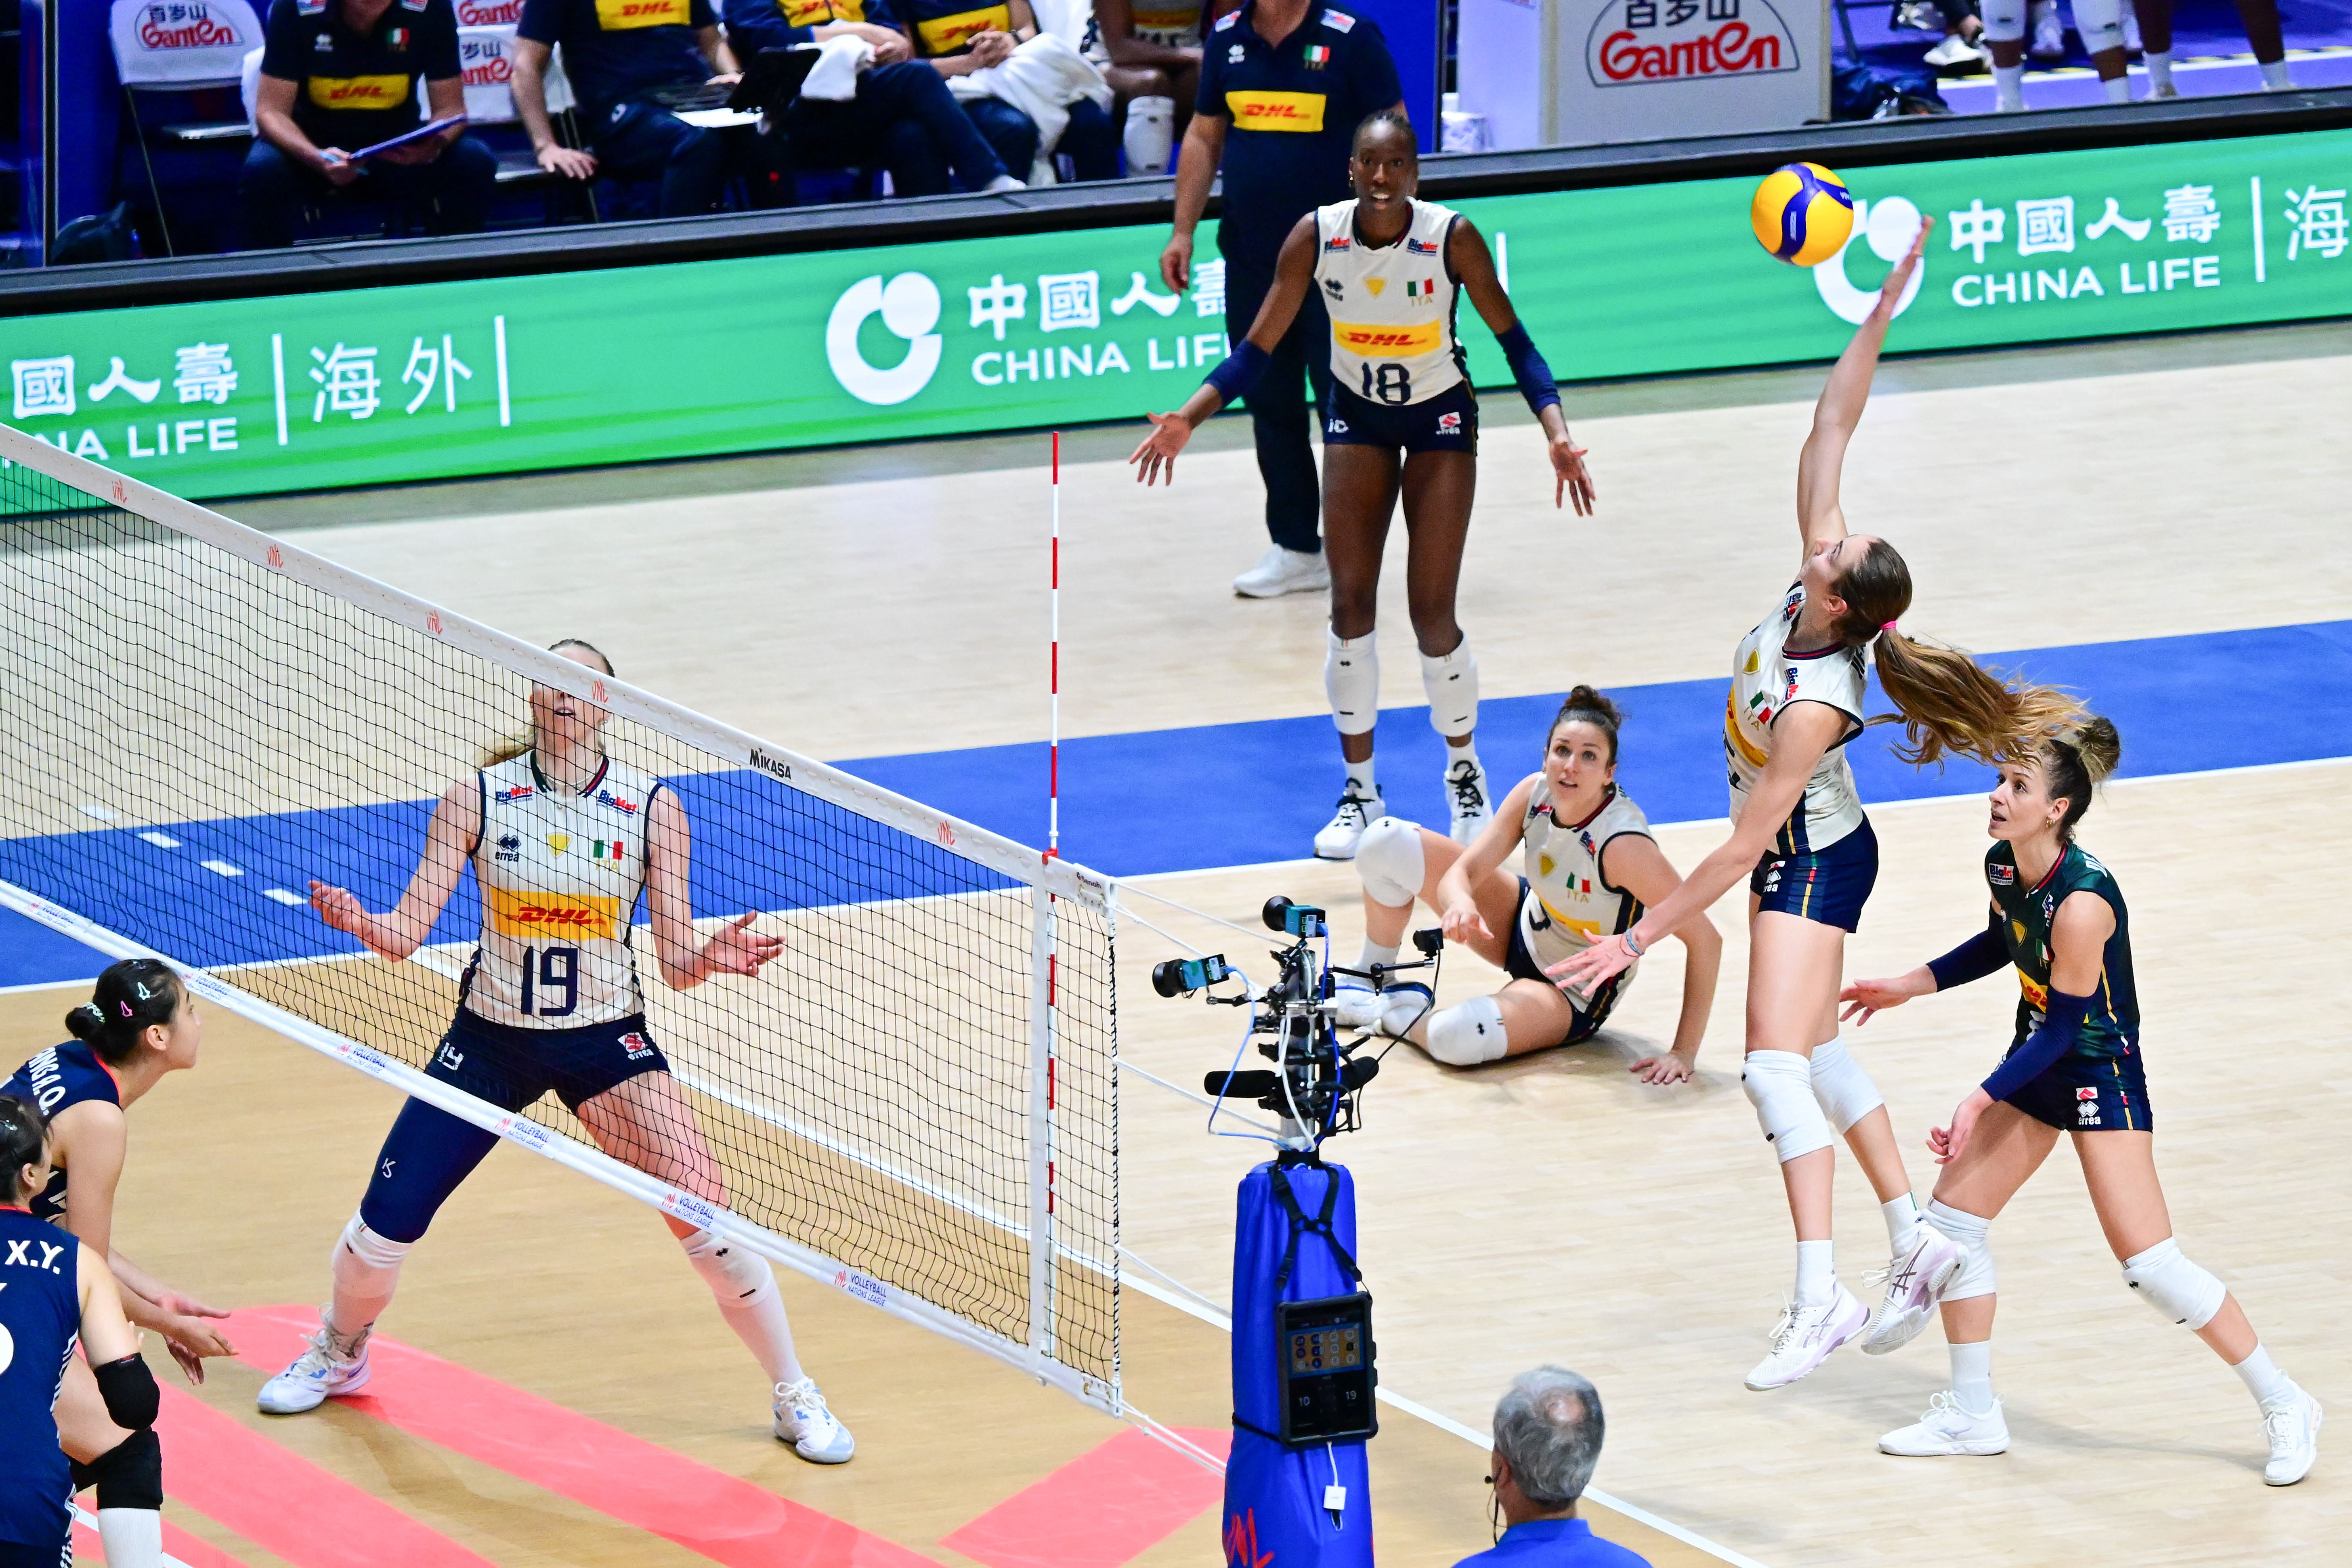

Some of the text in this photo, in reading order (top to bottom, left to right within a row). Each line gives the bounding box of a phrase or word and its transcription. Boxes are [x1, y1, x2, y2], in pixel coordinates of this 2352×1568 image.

[1244, 103, 1298, 117] DHL
[1948, 184, 2221, 264] 中國人壽
[1951, 255, 2221, 307] CHINA LIFE
[1348, 332, 1414, 346] DHL
[971, 342, 1130, 386] CHINA
[11, 334, 473, 423] 國人壽 海外
[1362, 361, 1411, 405] 18
[128, 417, 239, 458] LIFE
[749, 748, 792, 780] MIKASA
[496, 786, 532, 800] BigMat
[599, 789, 637, 812] BigMat
[495, 850, 519, 862] errea
[595, 860, 619, 871] ITA
[1081, 875, 1102, 889] Senoh
[1567, 890, 1588, 903] ITA
[518, 907, 595, 924] DHL
[521, 946, 578, 1016] 19
[353, 1047, 388, 1067] VOLLEYBALL
[514, 1121, 550, 1142] VOLLEYBALL
[2078, 1116, 2101, 1126] errea
[507, 1130, 544, 1149] NATIONS LEAGUE
[674, 1206, 711, 1228] NATIONS LEAGUE
[680, 1196, 715, 1220] VOLLEYBALL
[4, 1240, 64, 1274] X.Y.
[848, 1285, 885, 1306] NATIONS LEAGUE
[851, 1273, 886, 1297] VOLLEYBALL
[1299, 1396, 1310, 1406] 10
[1346, 1390, 1357, 1400] 19
